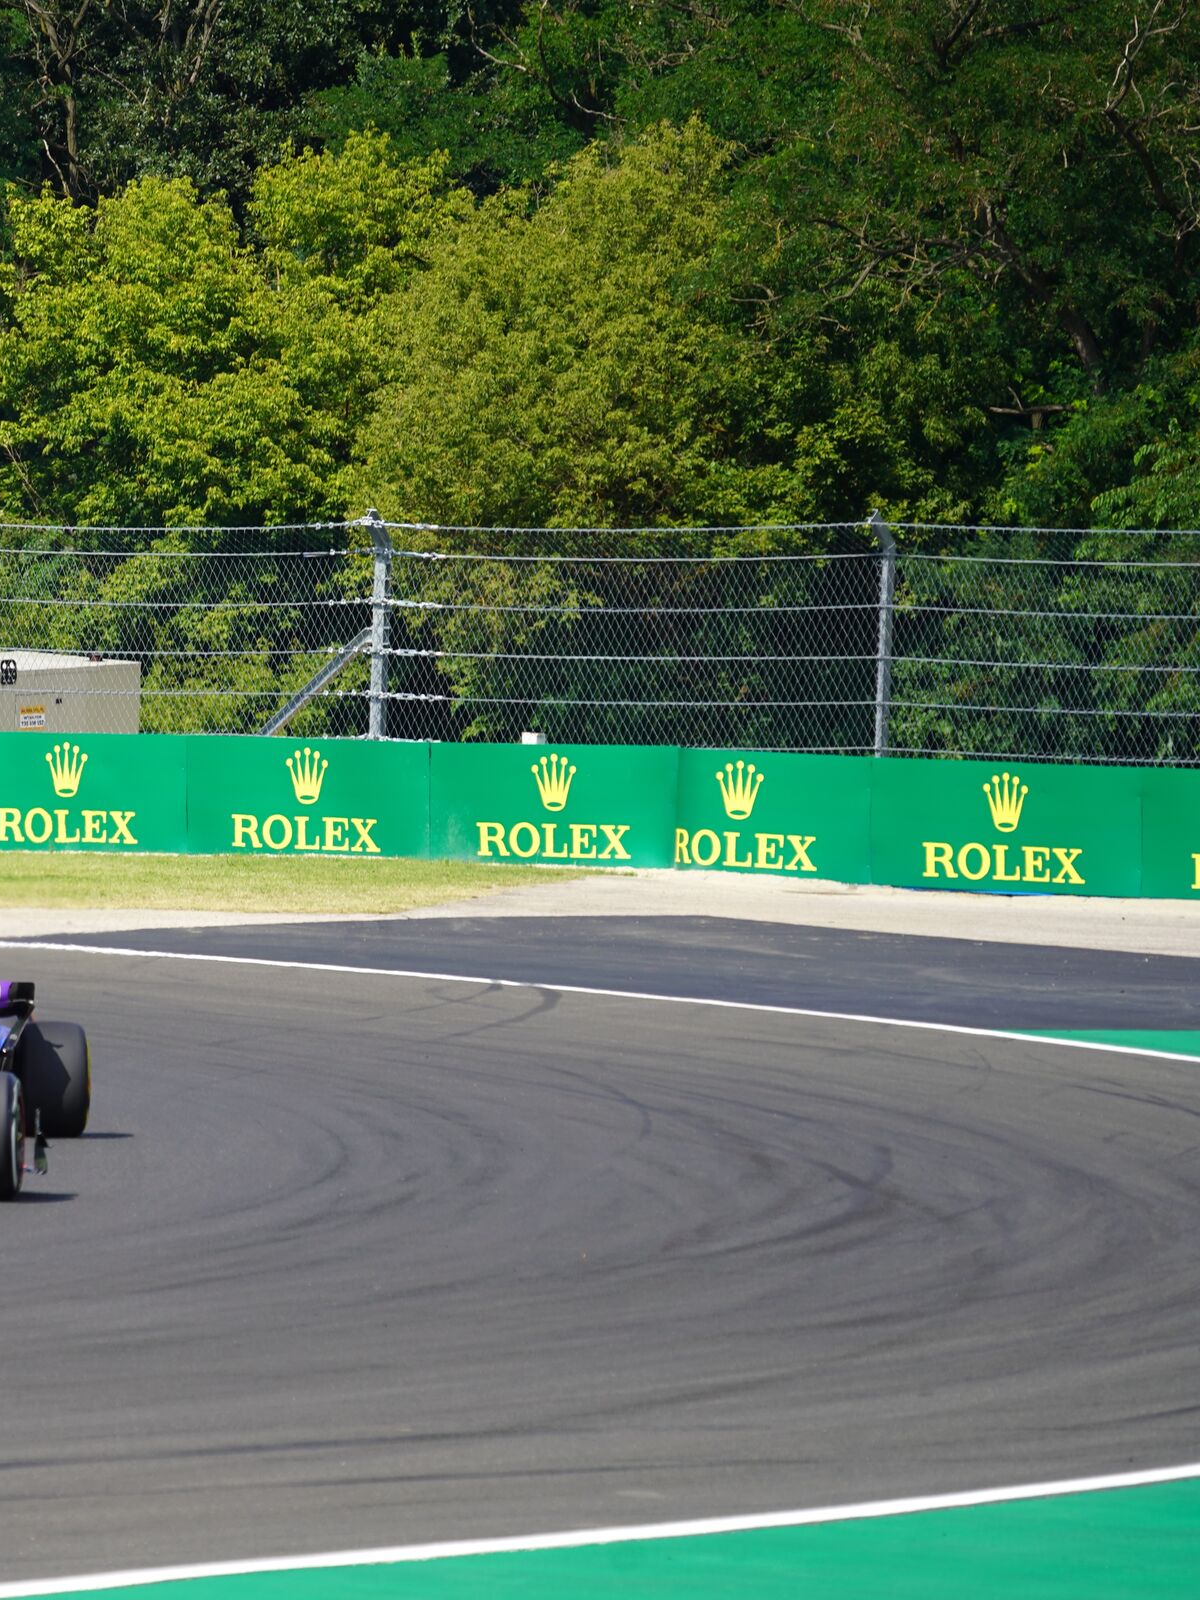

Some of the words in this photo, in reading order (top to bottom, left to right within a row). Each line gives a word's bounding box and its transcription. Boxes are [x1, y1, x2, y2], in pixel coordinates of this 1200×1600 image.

[231, 813, 381, 854] ROLEX
[476, 822, 632, 861] ROLEX
[675, 828, 818, 872] ROLEX
[922, 841, 1086, 885] ROLEX
